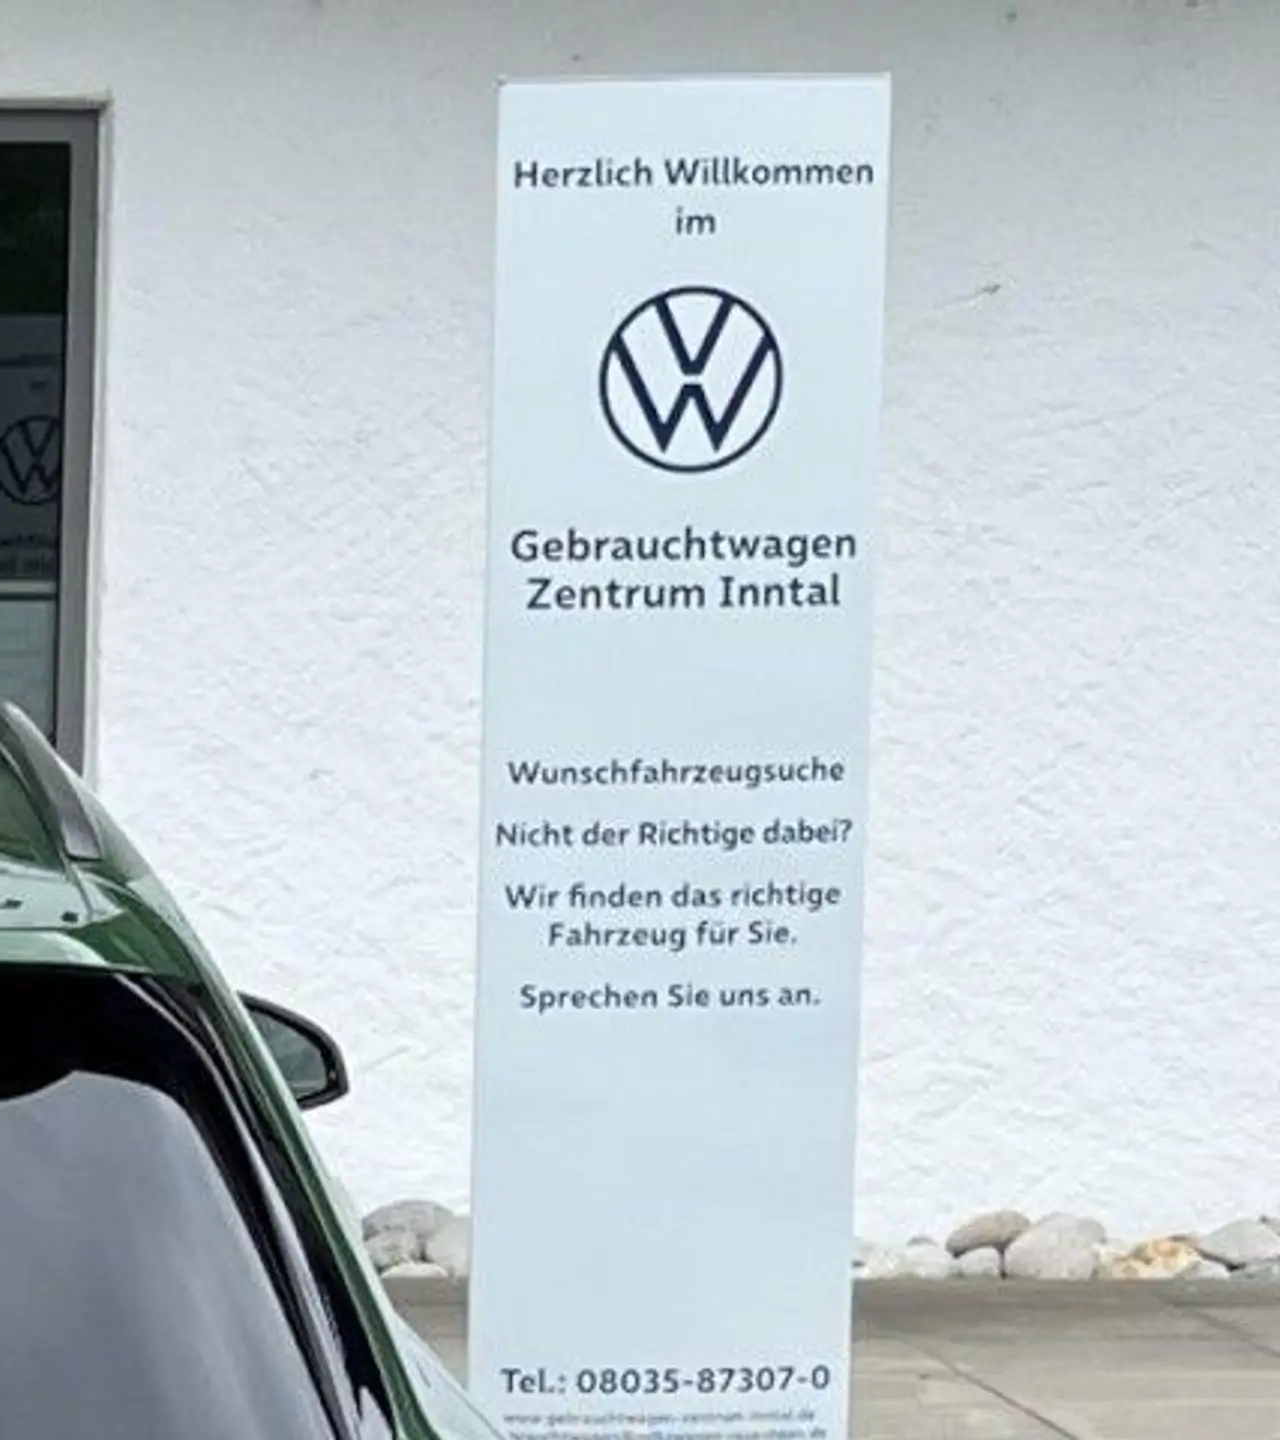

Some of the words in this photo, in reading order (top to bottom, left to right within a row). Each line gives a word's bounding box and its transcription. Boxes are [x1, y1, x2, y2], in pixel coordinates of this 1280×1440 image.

[514, 157, 653, 188] Herzlich
[664, 156, 874, 186] Willkommen
[675, 207, 716, 235] im
[511, 526, 856, 568] Gebrauchtwagen
[526, 577, 706, 610] Zentrum
[719, 572, 840, 608] Inntal
[507, 756, 845, 789] Wunschfahrzeugsuche
[496, 822, 573, 847] Nicht
[581, 821, 630, 847] der
[638, 820, 756, 851] Richtige
[762, 818, 853, 845] dabei?
[504, 884, 560, 909] Wir
[568, 882, 663, 909] finden
[670, 883, 722, 908] das
[730, 880, 841, 913] richtige
[548, 921, 687, 953] Fahrzeug
[696, 919, 739, 946] für
[748, 920, 797, 945] Sie.
[520, 983, 658, 1015] Sprechen
[667, 983, 710, 1009] Sie
[719, 988, 770, 1007] uns
[777, 987, 820, 1006] an.
[500, 1367, 566, 1394] Tel.:
[575, 1364, 831, 1395] 08035-87307-0
